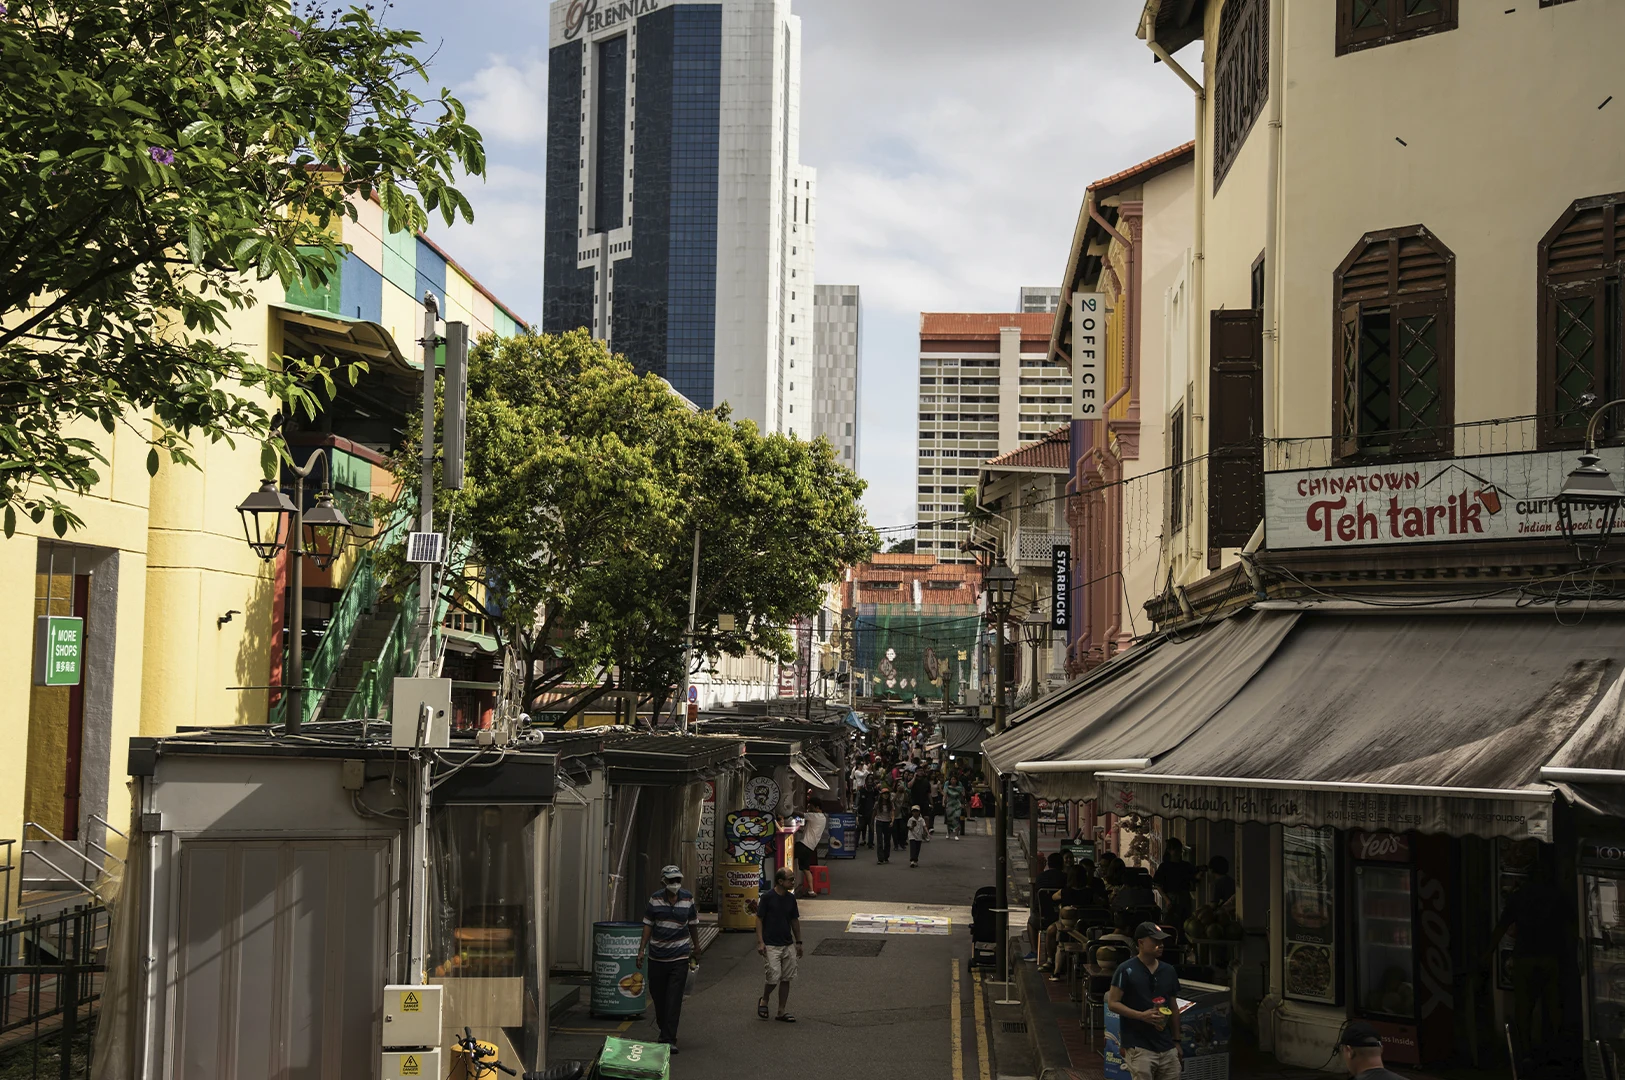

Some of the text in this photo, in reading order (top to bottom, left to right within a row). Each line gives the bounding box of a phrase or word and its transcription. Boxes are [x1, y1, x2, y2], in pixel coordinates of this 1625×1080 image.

[564, 0, 658, 40] PERENNIAL
[1082, 318, 1095, 413] OFFICES
[1297, 471, 1420, 497] CHINATOWN
[1306, 486, 1484, 542] Teh tarik
[1518, 521, 1552, 535] Indian
[1057, 551, 1066, 625] STARBUCKS
[58, 630, 76, 641] MORE
[55, 645, 77, 656] SHOPS
[55, 661, 75, 672] 更多商店
[745, 782, 755, 793] ICE
[755, 778, 778, 795] CREAM
[1161, 792, 1300, 817] Chinatown Teh Tarik
[599, 945, 639, 957] Singapo
[627, 1044, 643, 1062] Grab
